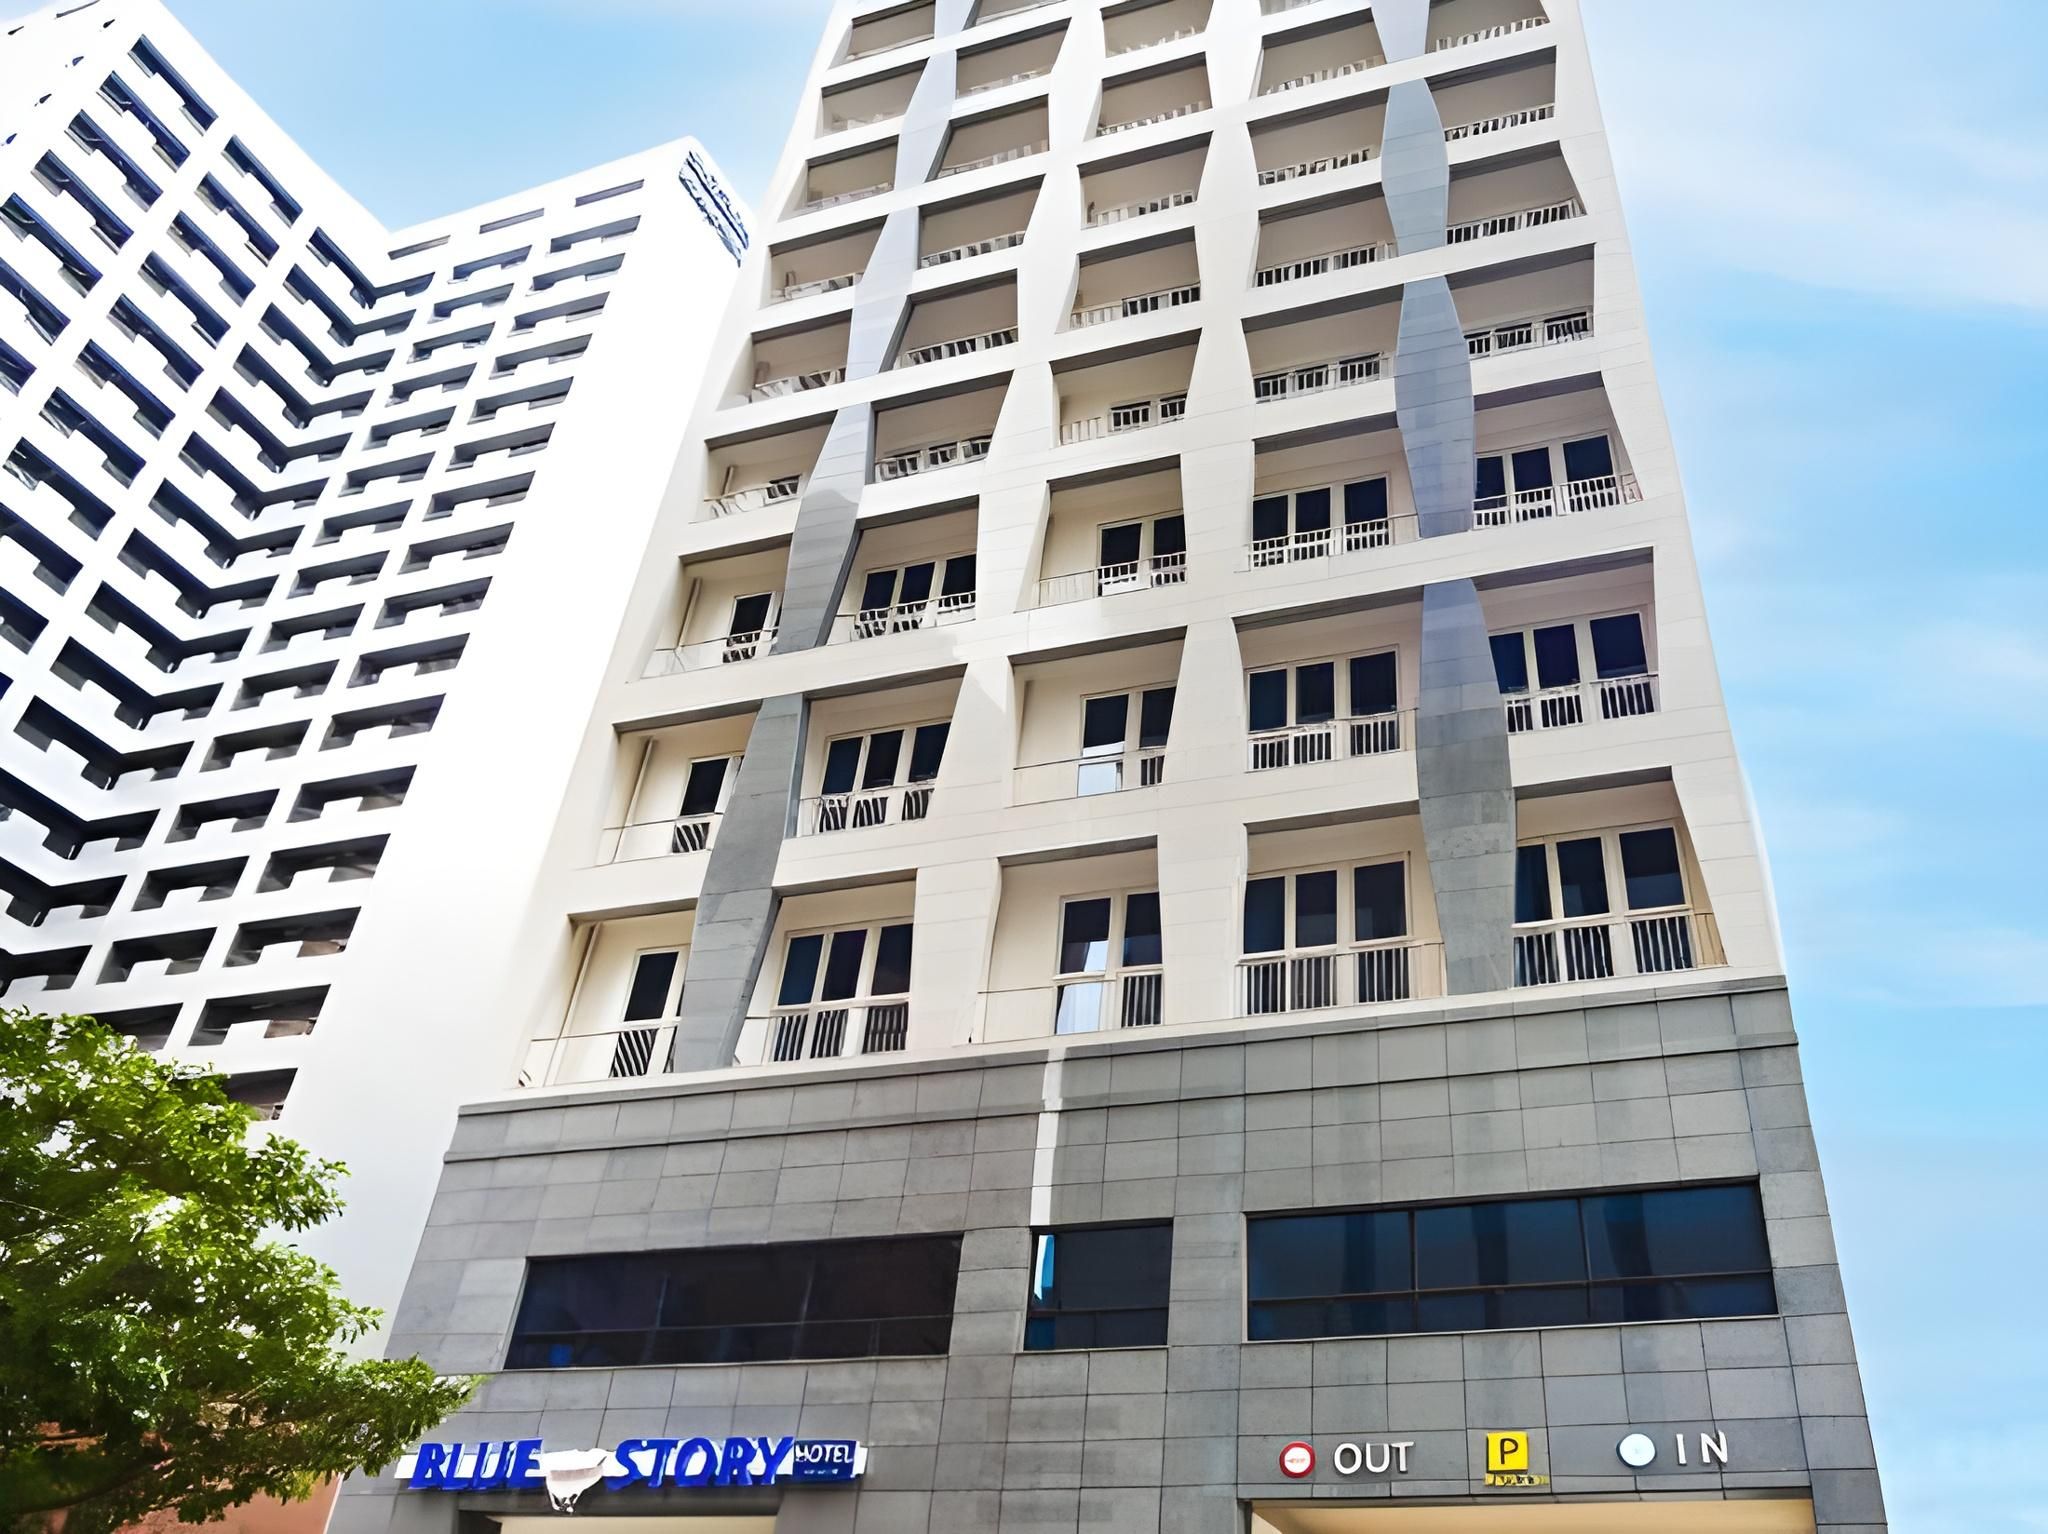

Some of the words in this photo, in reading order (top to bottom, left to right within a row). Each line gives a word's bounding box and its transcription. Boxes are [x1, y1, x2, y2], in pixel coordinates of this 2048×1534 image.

[408, 1439, 544, 1489] BLUE
[605, 1436, 795, 1490] STORY
[795, 1444, 853, 1464] HOTEL
[1333, 1441, 1415, 1475] OUT
[1500, 1438, 1519, 1465] P
[1676, 1429, 1728, 1464] IN
